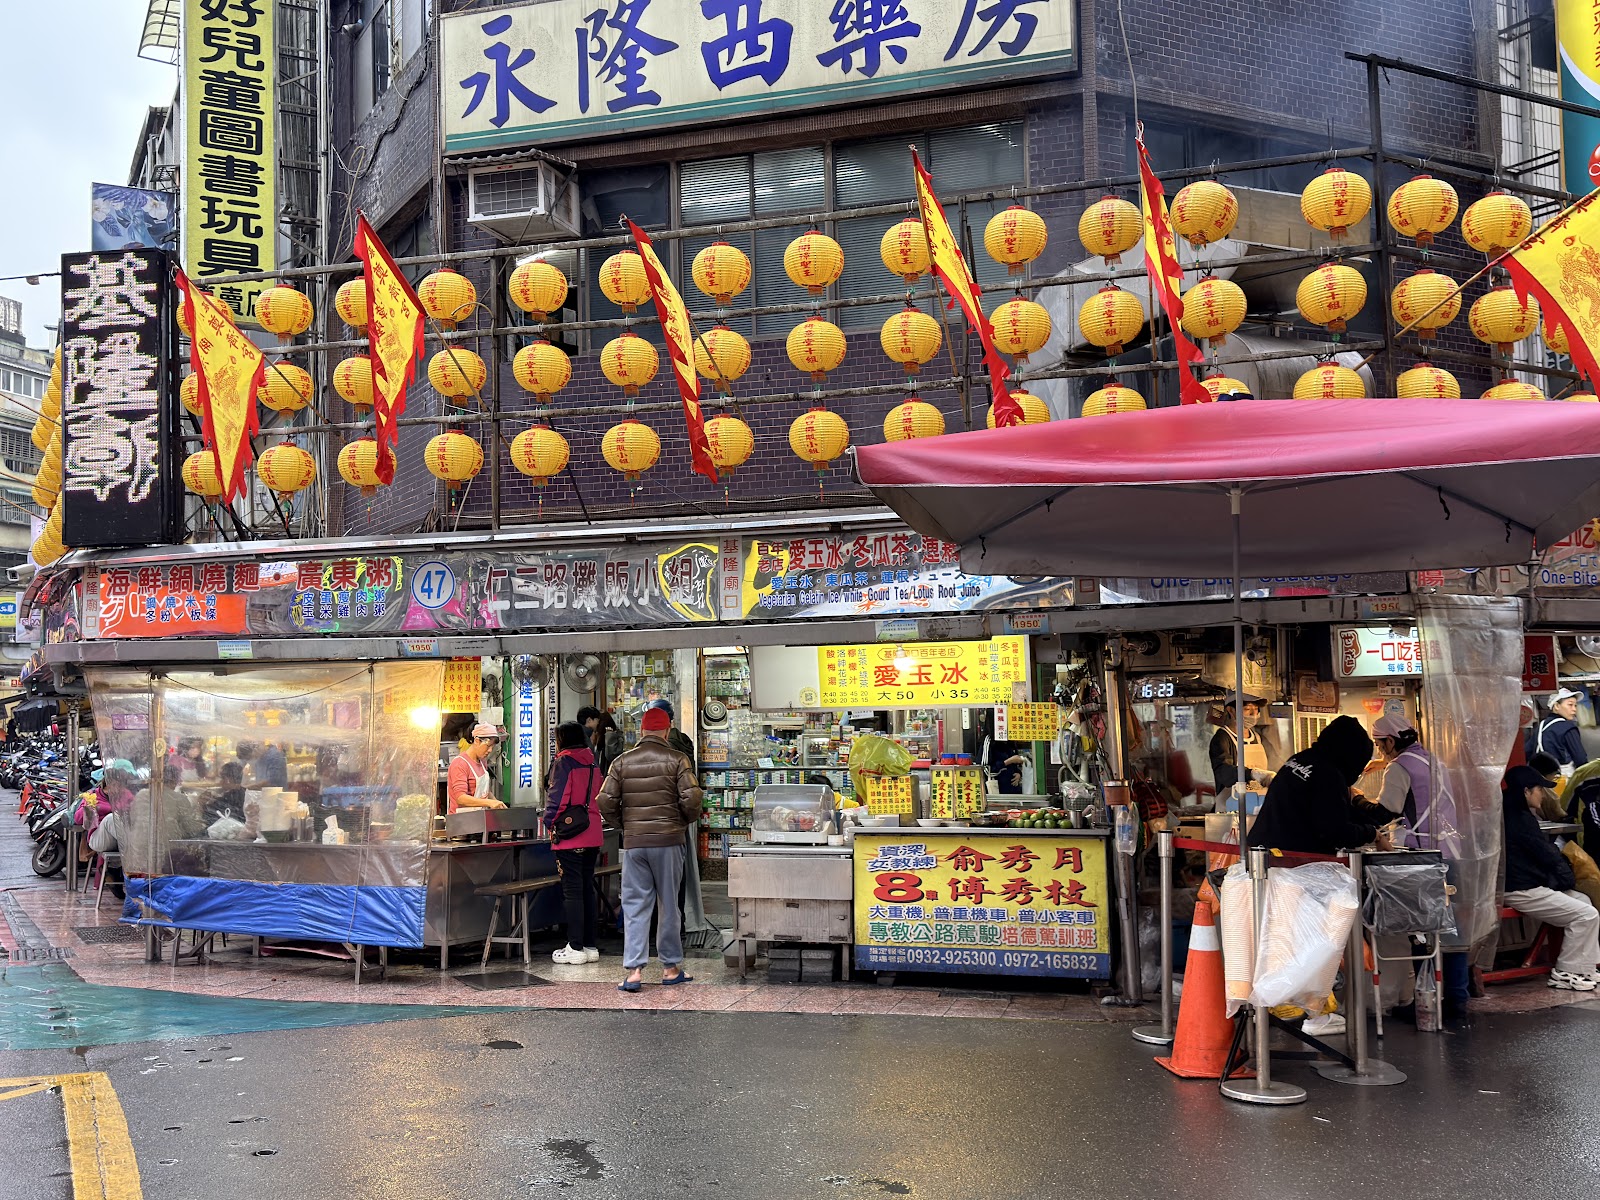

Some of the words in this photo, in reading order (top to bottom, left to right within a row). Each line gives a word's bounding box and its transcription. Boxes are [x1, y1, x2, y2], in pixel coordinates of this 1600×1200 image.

[198, 0, 265, 282] 好兒童圖書玩具
[723, 538, 739, 609] 基隆廟口
[757, 557, 784, 573] 老店
[107, 561, 261, 598] 海鮮鍋燒麵
[296, 558, 393, 591] 廣東粥
[421, 570, 447, 600] 47
[486, 556, 694, 614] 仁二路攤販小組
[1541, 569, 1597, 585] One-Bite
[145, 595, 217, 609] 鍋燒米粉
[302, 589, 386, 605] 皮蛋瘦肉粥
[758, 592, 796, 609] Vegetarian
[800, 591, 824, 606] Gelatin
[868, 587, 890, 601] Gourd
[938, 584, 957, 598] Root
[960, 584, 981, 599] Juice
[302, 603, 386, 618] 玉米雞肉粥
[1014, 620, 1038, 628] 1950
[873, 661, 969, 688] 愛玉冰
[1142, 683, 1174, 698] 16:23
[879, 843, 926, 858] 資深
[945, 845, 1084, 873] 俞秀月
[868, 856, 937, 871] 女教練
[947, 875, 1098, 907] 傅秀枝
